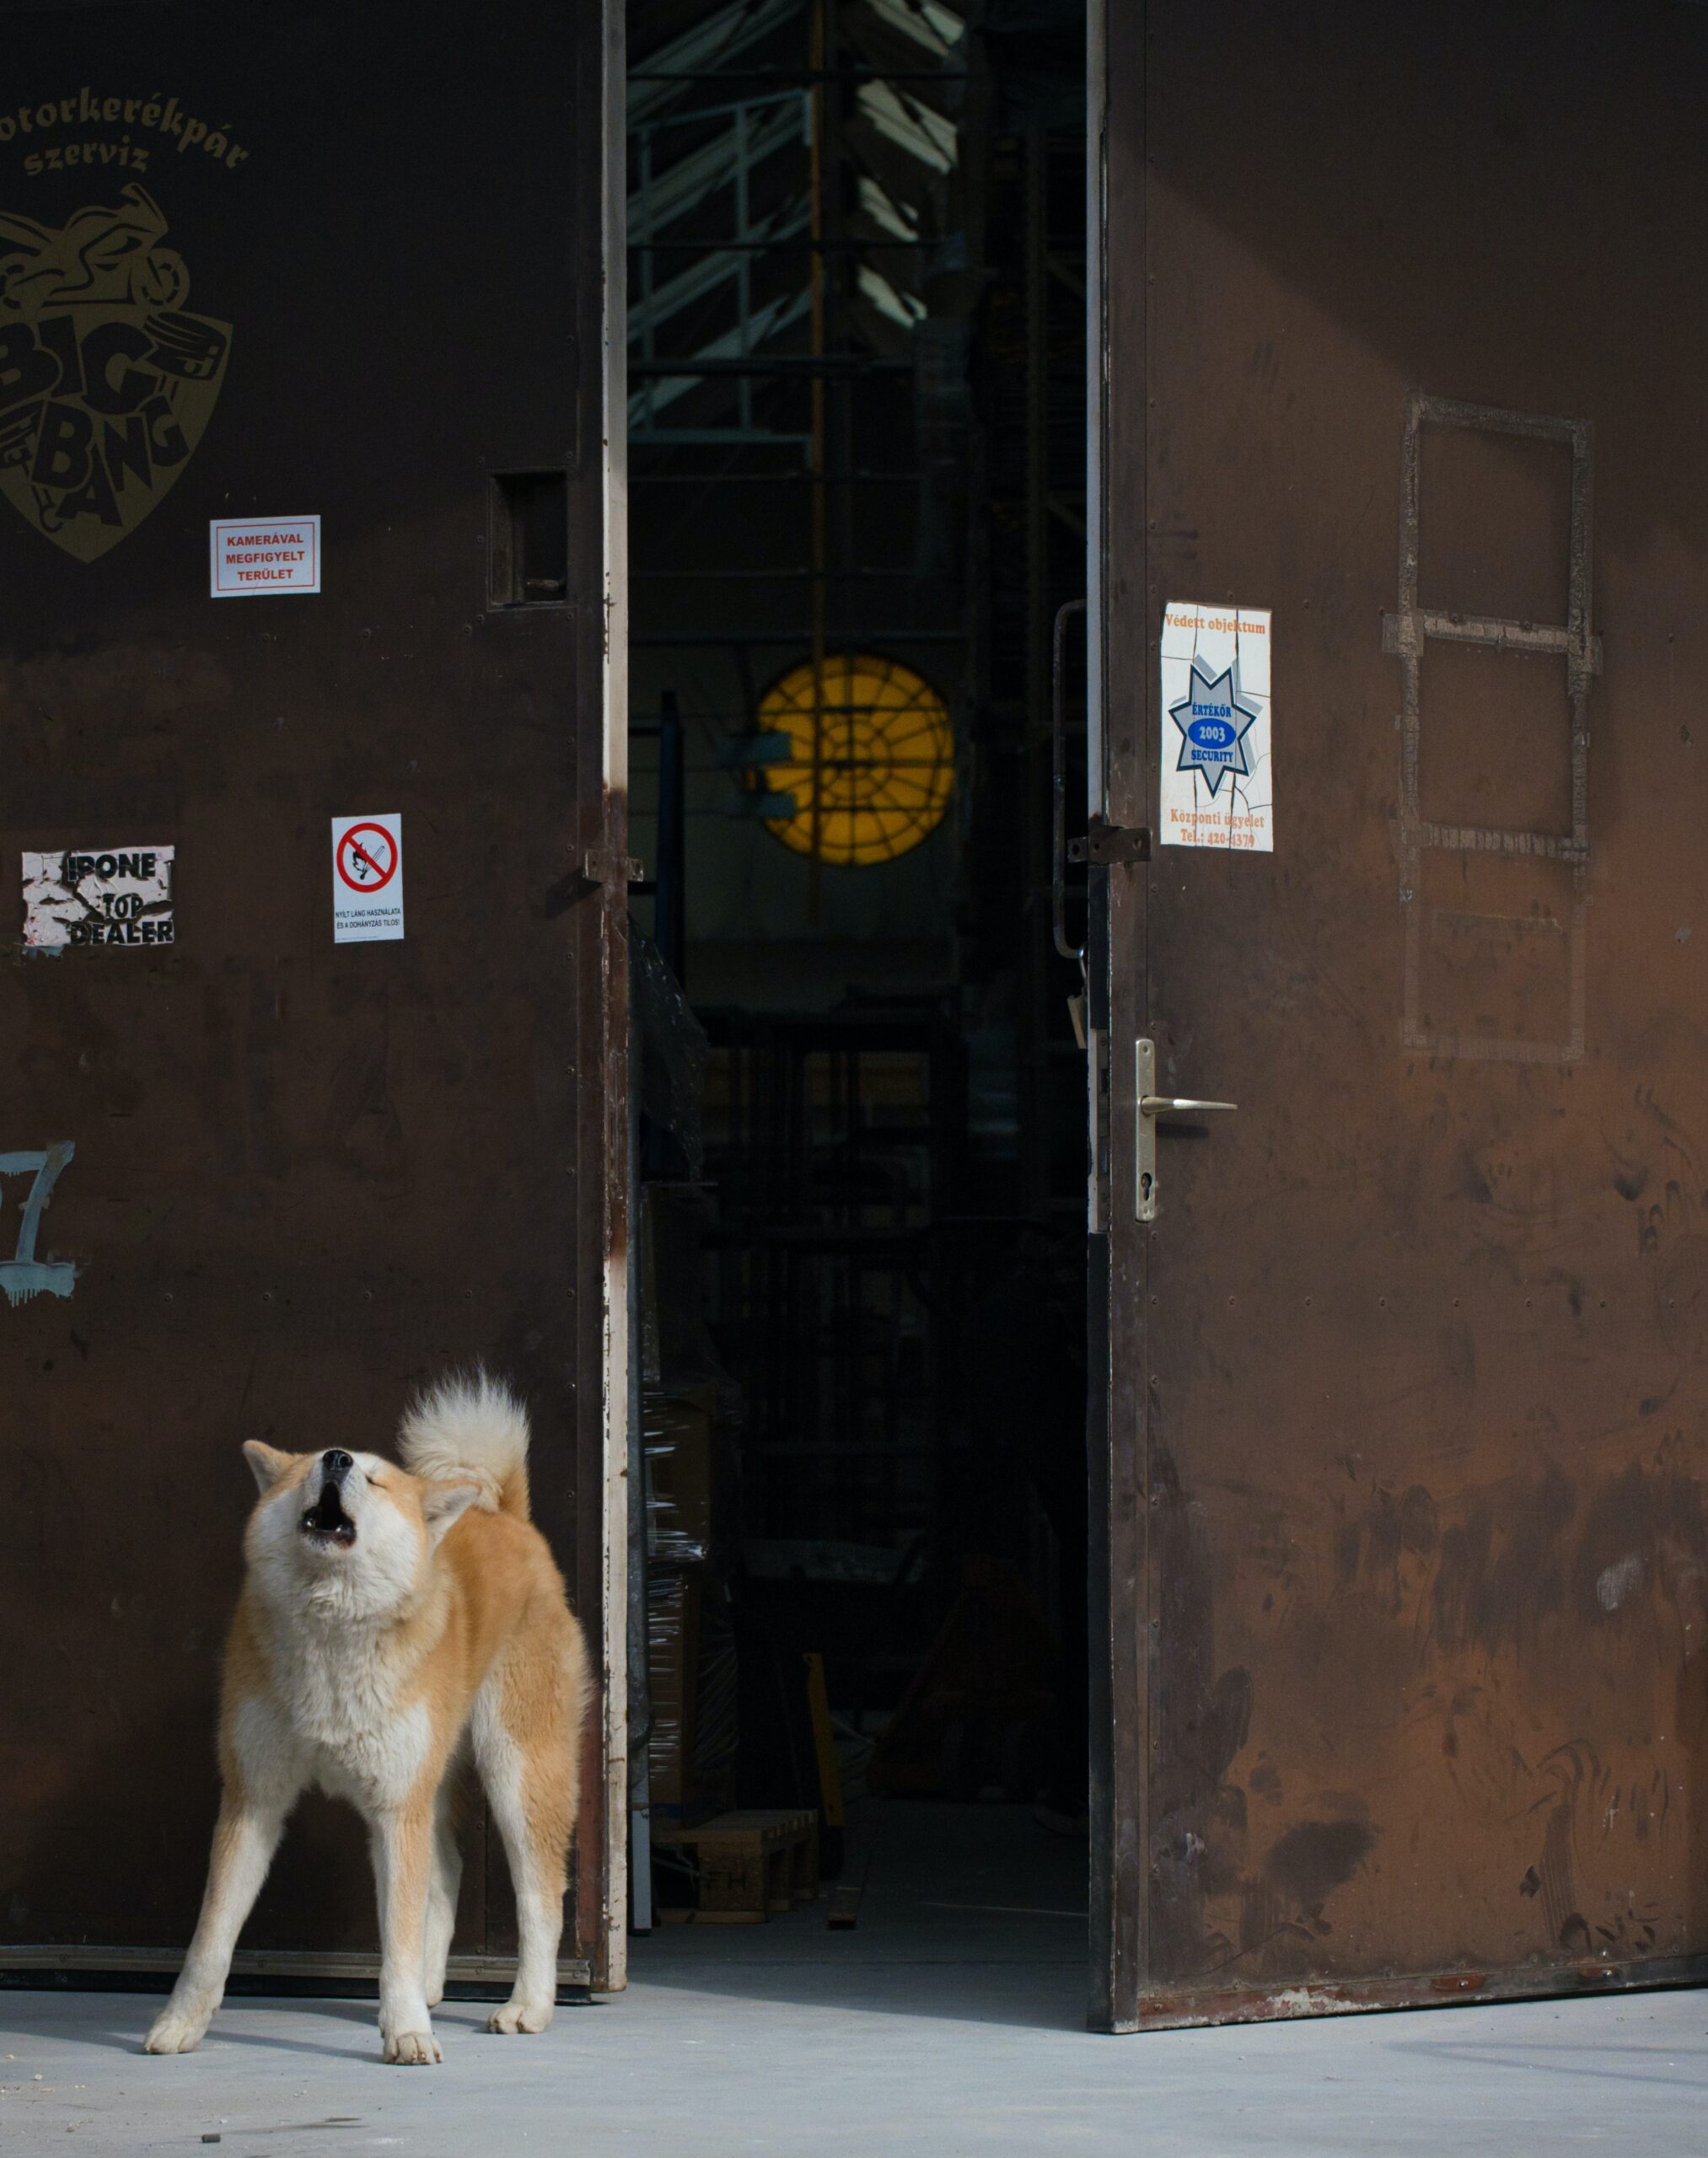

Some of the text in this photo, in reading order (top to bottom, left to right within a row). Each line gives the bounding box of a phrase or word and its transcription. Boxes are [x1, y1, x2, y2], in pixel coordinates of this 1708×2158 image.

[24, 135, 150, 175] szerviz
[31, 395, 191, 527] BANG
[227, 533, 303, 546] KAMERÁVAL
[226, 551, 304, 564] MEGFIGYELT
[238, 568, 293, 581] TERÜLET
[1166, 614, 1265, 634] Védett objektum
[1192, 702, 1232, 717] ÉRTÉKŐR
[1199, 726, 1226, 742] 2003
[1191, 749, 1233, 762] SECURITY
[1170, 809, 1265, 829] Központi ügyelet
[1180, 829, 1204, 843] Tel.:
[67, 853, 155, 882] IPONE
[102, 892, 143, 919] TOP
[350, 920, 382, 928] DOHÁNYZÁS
[69, 921, 173, 945] DEALER
